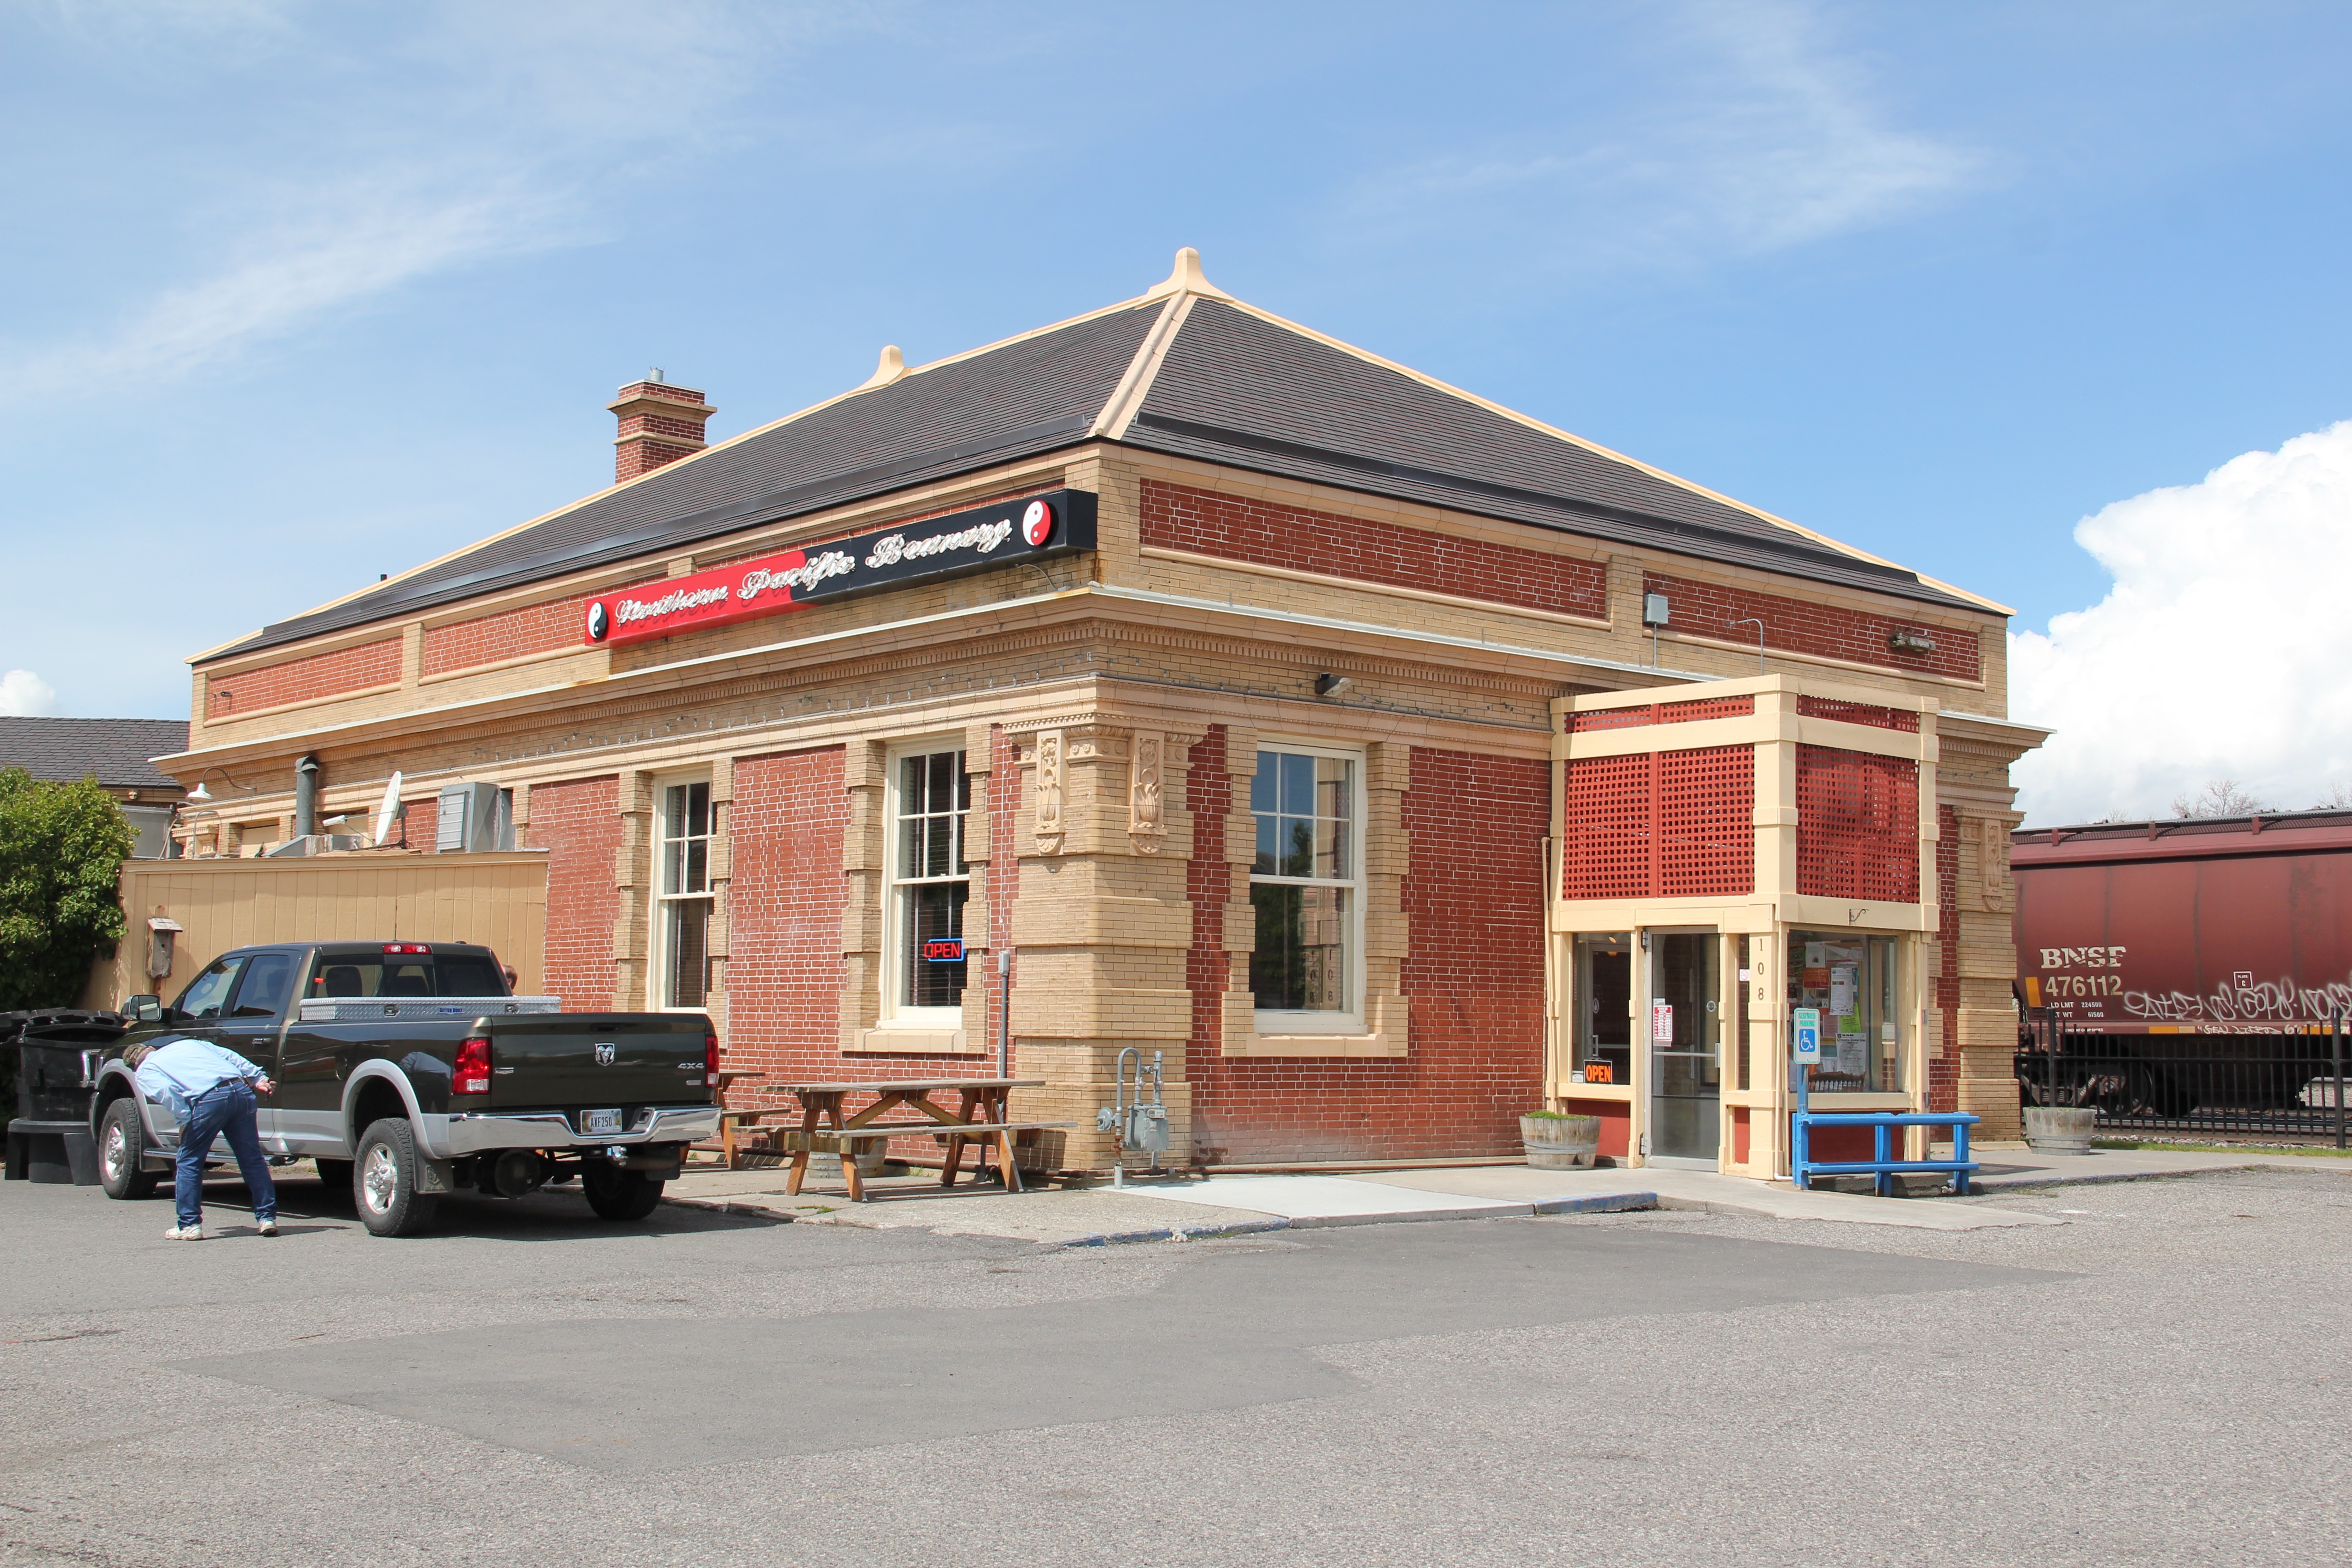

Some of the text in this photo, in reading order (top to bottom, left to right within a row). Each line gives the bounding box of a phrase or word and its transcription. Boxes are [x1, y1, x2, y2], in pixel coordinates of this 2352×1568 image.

[615, 519, 1013, 627] Northern Pacific Beanery
[924, 942, 960, 958] OPEN
[2039, 946, 2127, 969] BNSF
[2045, 975, 2123, 997] 476112
[1586, 1064, 1611, 1083] OPEN
[591, 1117, 612, 1127] AXF250
